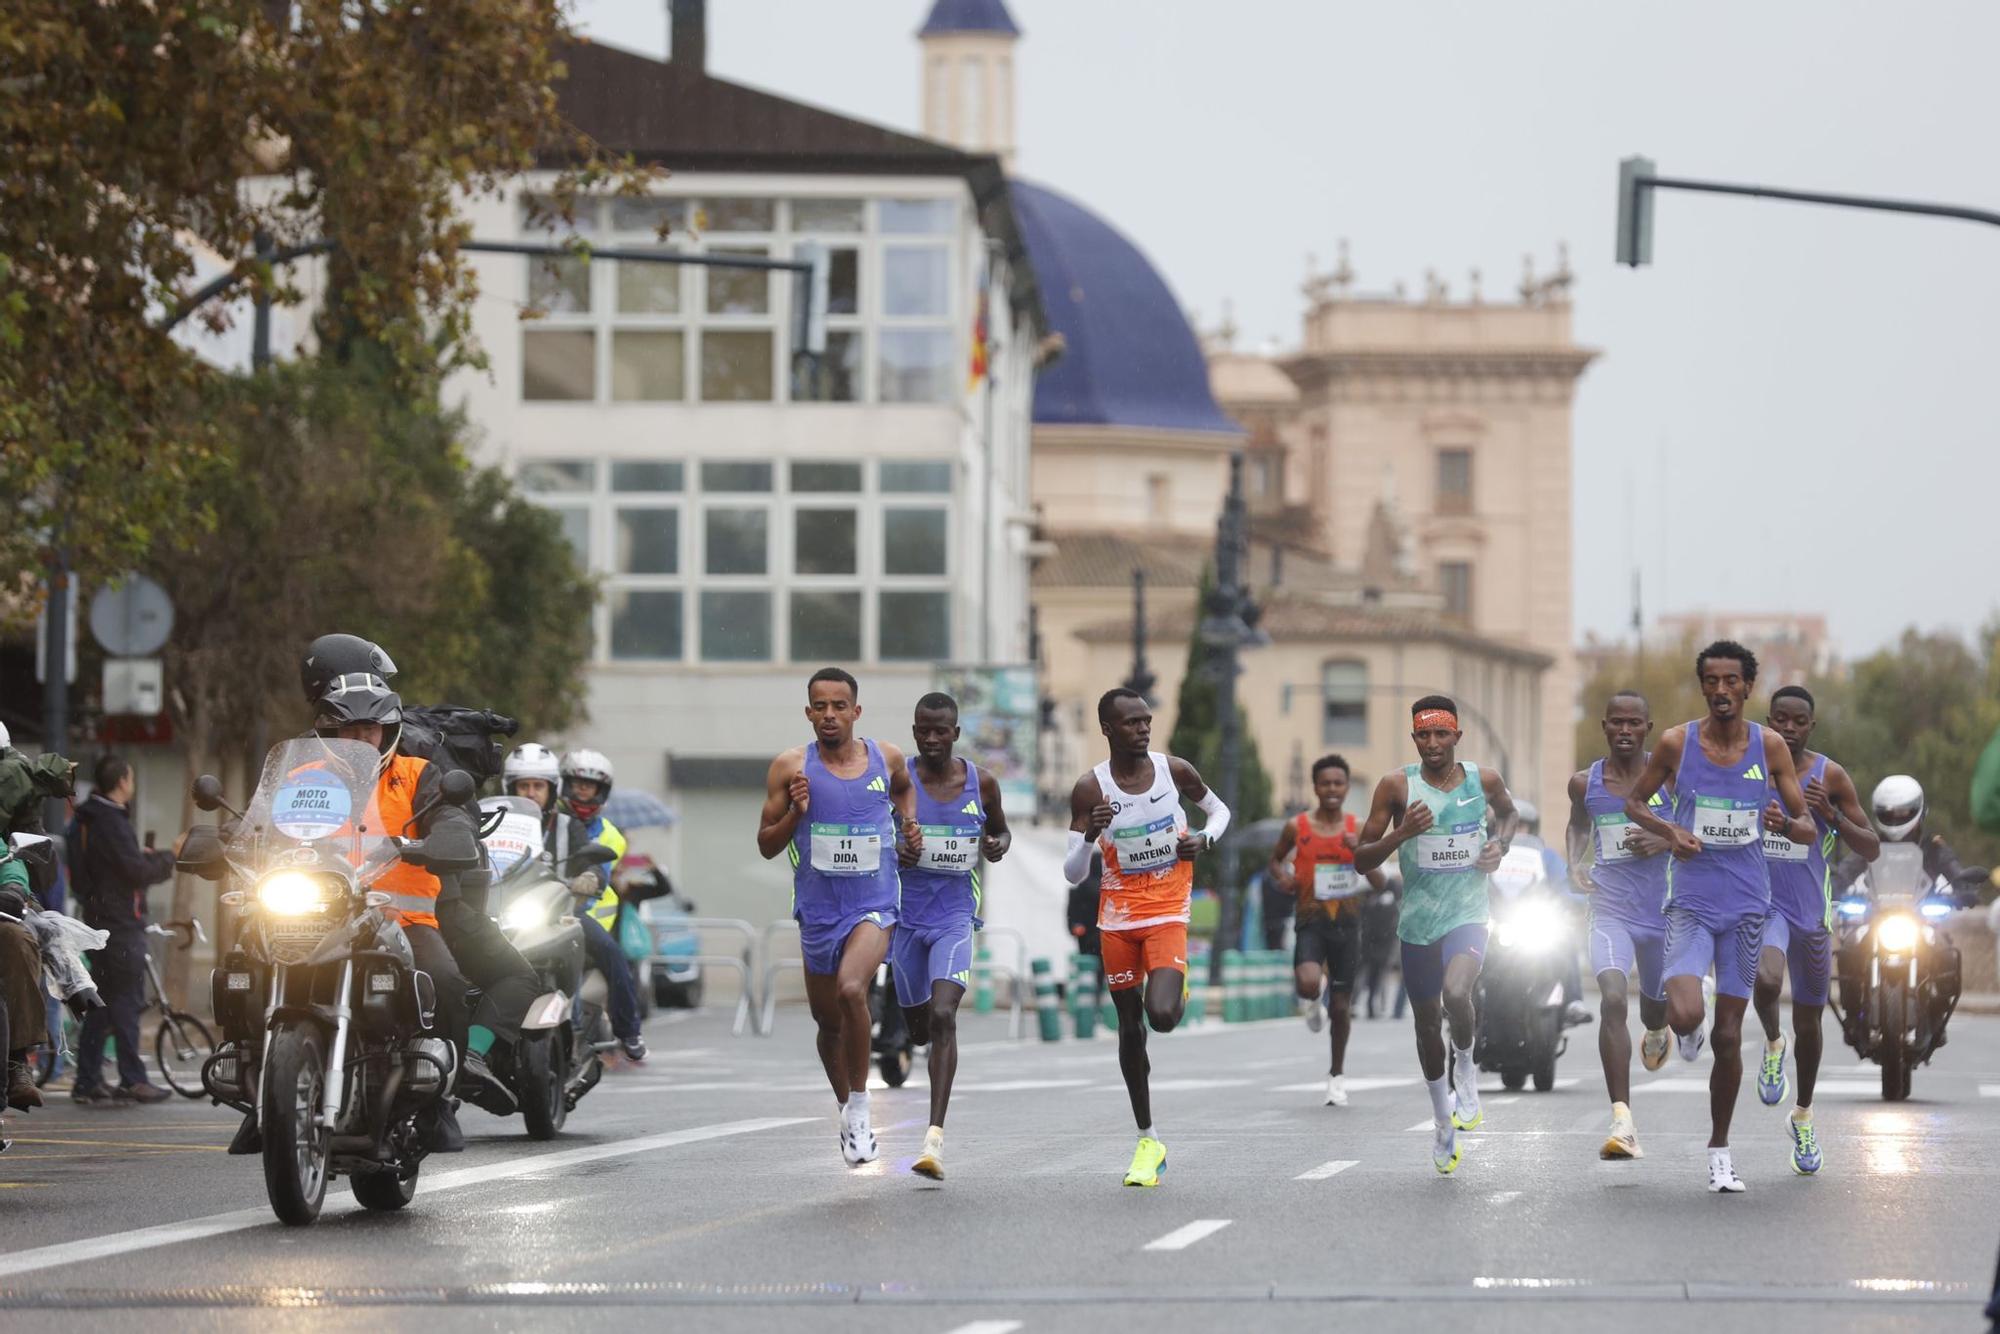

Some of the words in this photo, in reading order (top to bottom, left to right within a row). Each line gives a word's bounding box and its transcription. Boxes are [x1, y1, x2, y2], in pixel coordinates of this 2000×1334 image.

[296, 789, 328, 799] MOTO
[291, 799, 331, 809] OFICIAL
[1727, 813, 1732, 824] 1
[840, 839, 852, 849] 11
[945, 840, 957, 850] 10
[1145, 838, 1152, 847] 4
[1448, 838, 1455, 848] 2
[833, 853, 858, 863] DIDA
[931, 853, 968, 863] LANGAT
[1129, 844, 1171, 862] MATEIKO
[1432, 849, 1470, 861] BAREGA
